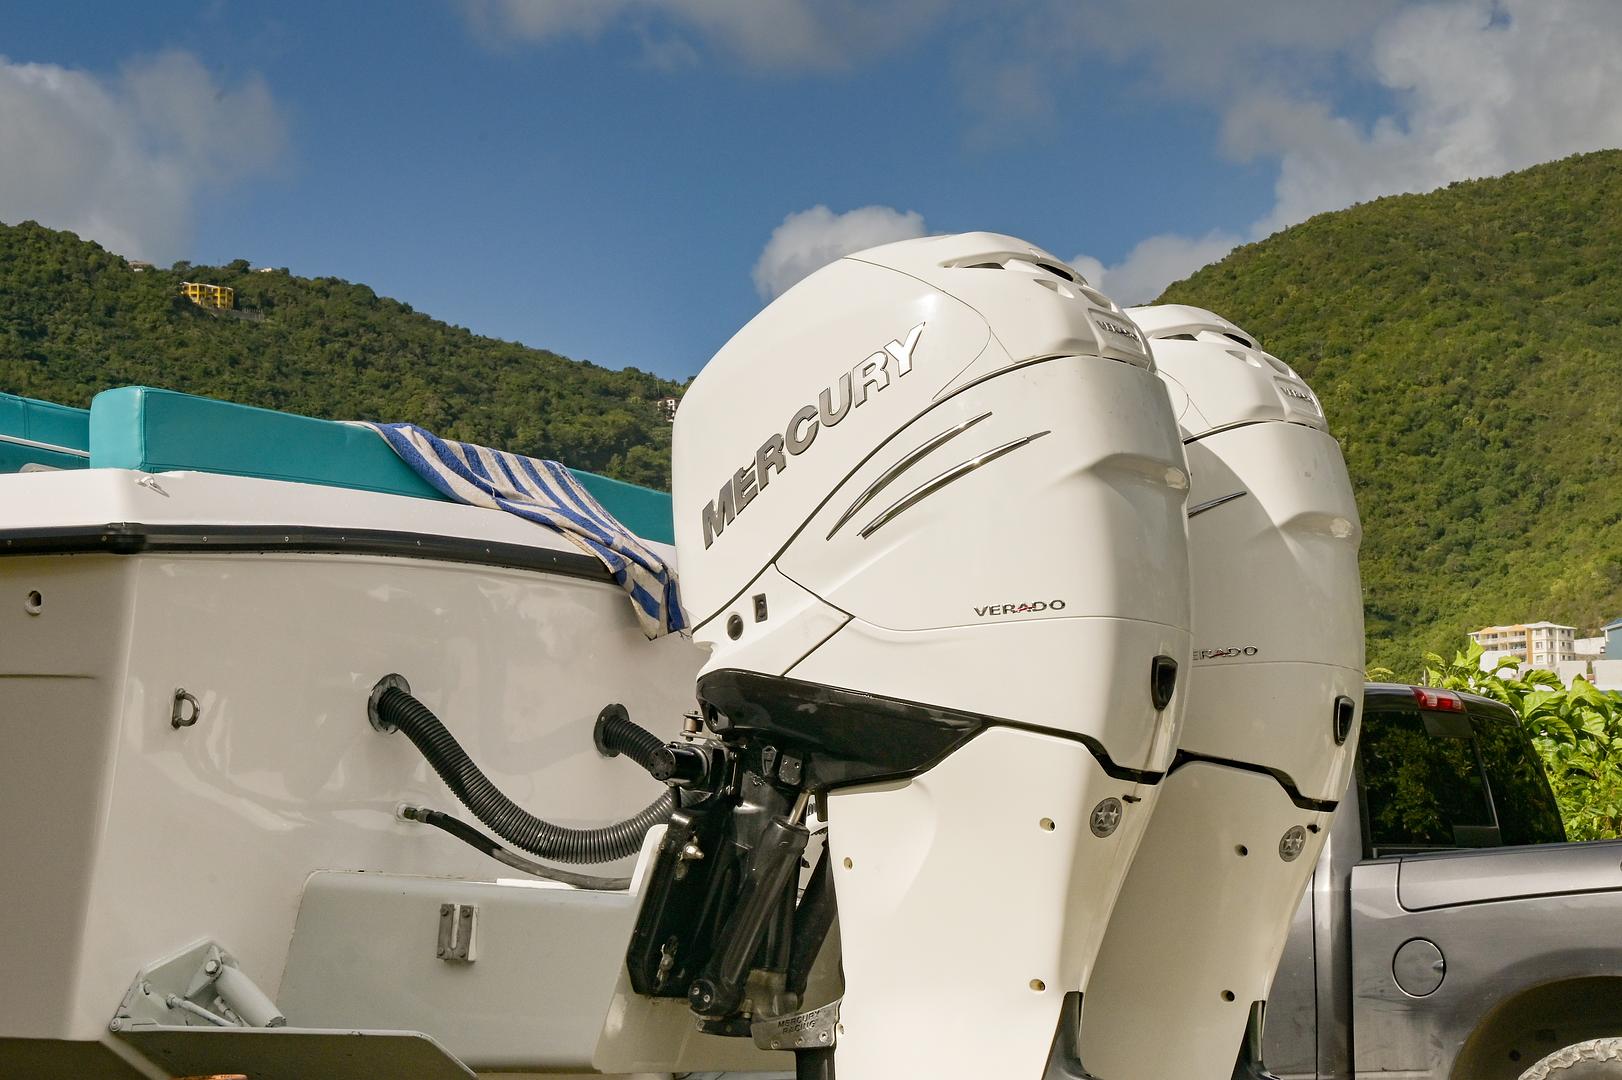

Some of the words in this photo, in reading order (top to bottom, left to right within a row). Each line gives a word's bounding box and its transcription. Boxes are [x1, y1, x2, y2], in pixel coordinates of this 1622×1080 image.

[702, 321, 926, 551] MERCURY
[974, 599, 1066, 617] VERADO
[1192, 645, 1259, 661] ERADO
[777, 1009, 821, 1028] MERCURY
[782, 1020, 816, 1034] RACING
